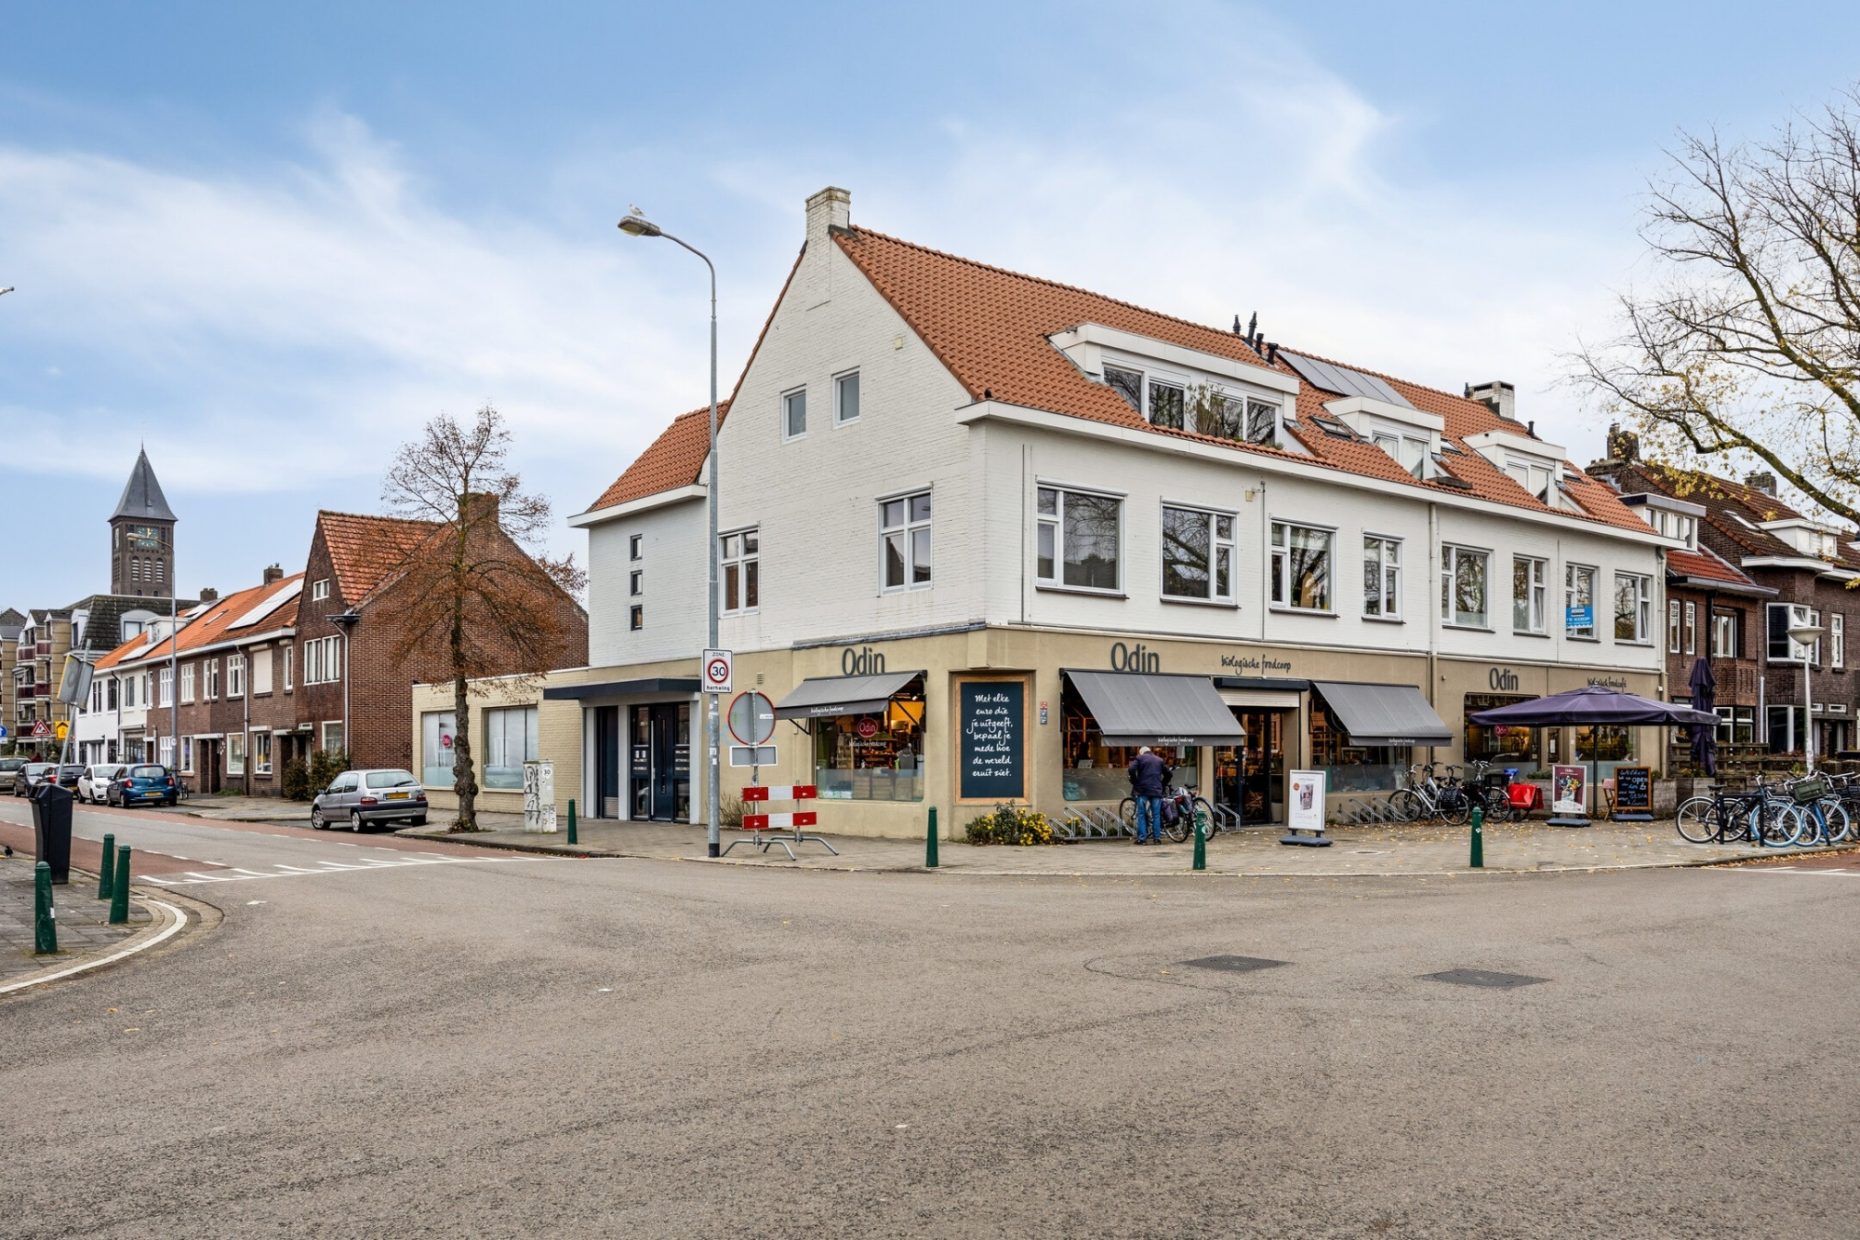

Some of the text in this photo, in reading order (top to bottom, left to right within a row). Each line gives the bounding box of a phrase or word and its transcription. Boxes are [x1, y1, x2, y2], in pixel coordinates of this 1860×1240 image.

[841, 646, 885, 676] Odin
[1110, 642, 1160, 672] Odin
[1221, 653, 1292, 676] biologische foodcoop
[711, 666, 726, 677] 30
[1489, 667, 1519, 691] Odin
[974, 692, 1009, 702] Met elke
[994, 706, 1008, 715] die
[966, 716, 1014, 735] je uitgeeft,
[973, 730, 1012, 746] bepaal je
[974, 743, 1011, 752] mede hoe
[972, 754, 1012, 765] de wereld
[971, 768, 992, 777] eruit
